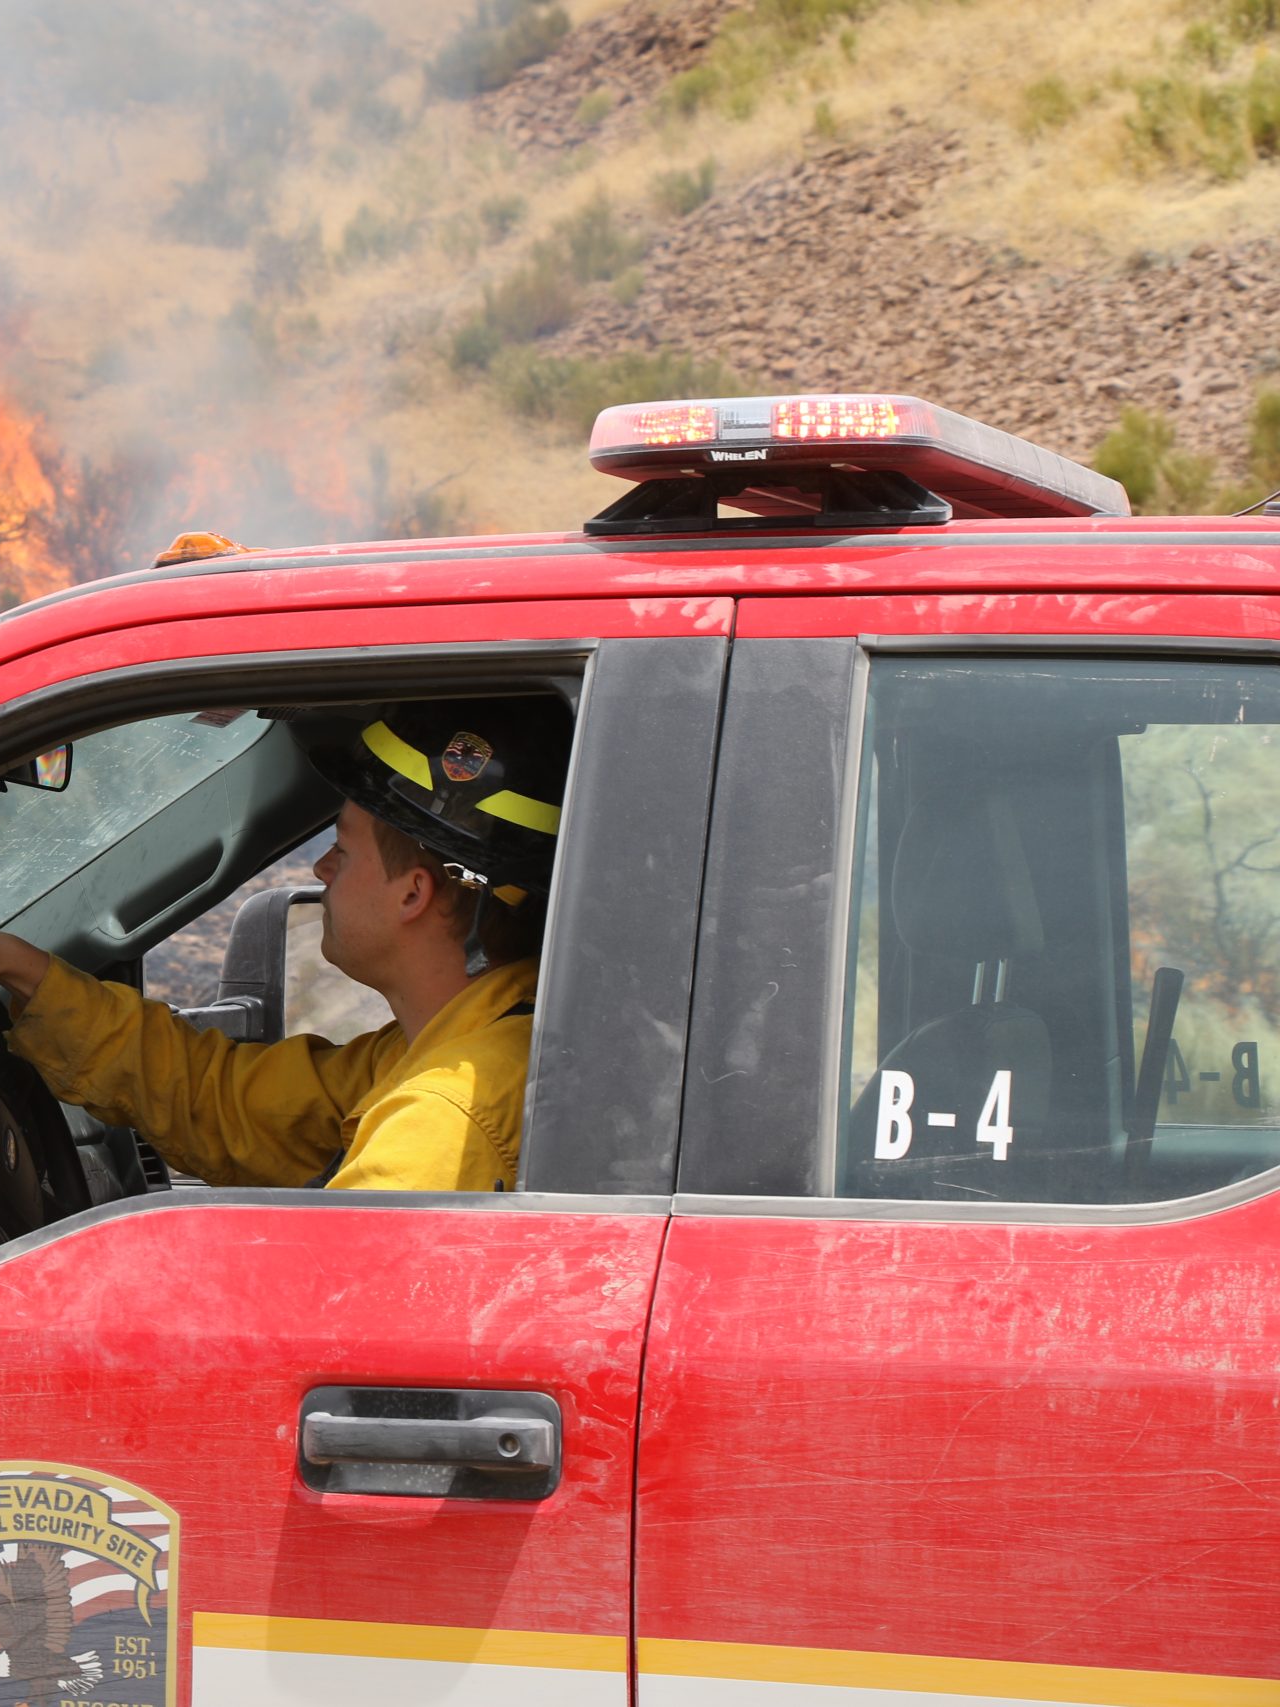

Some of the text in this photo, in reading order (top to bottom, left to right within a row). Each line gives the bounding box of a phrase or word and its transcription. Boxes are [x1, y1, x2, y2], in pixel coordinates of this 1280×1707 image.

[12, 1512, 105, 1545] SECURITY
[105, 1534, 149, 1568] SITE
[114, 1636, 156, 1656] EST.
[112, 1658, 158, 1679] 1951
